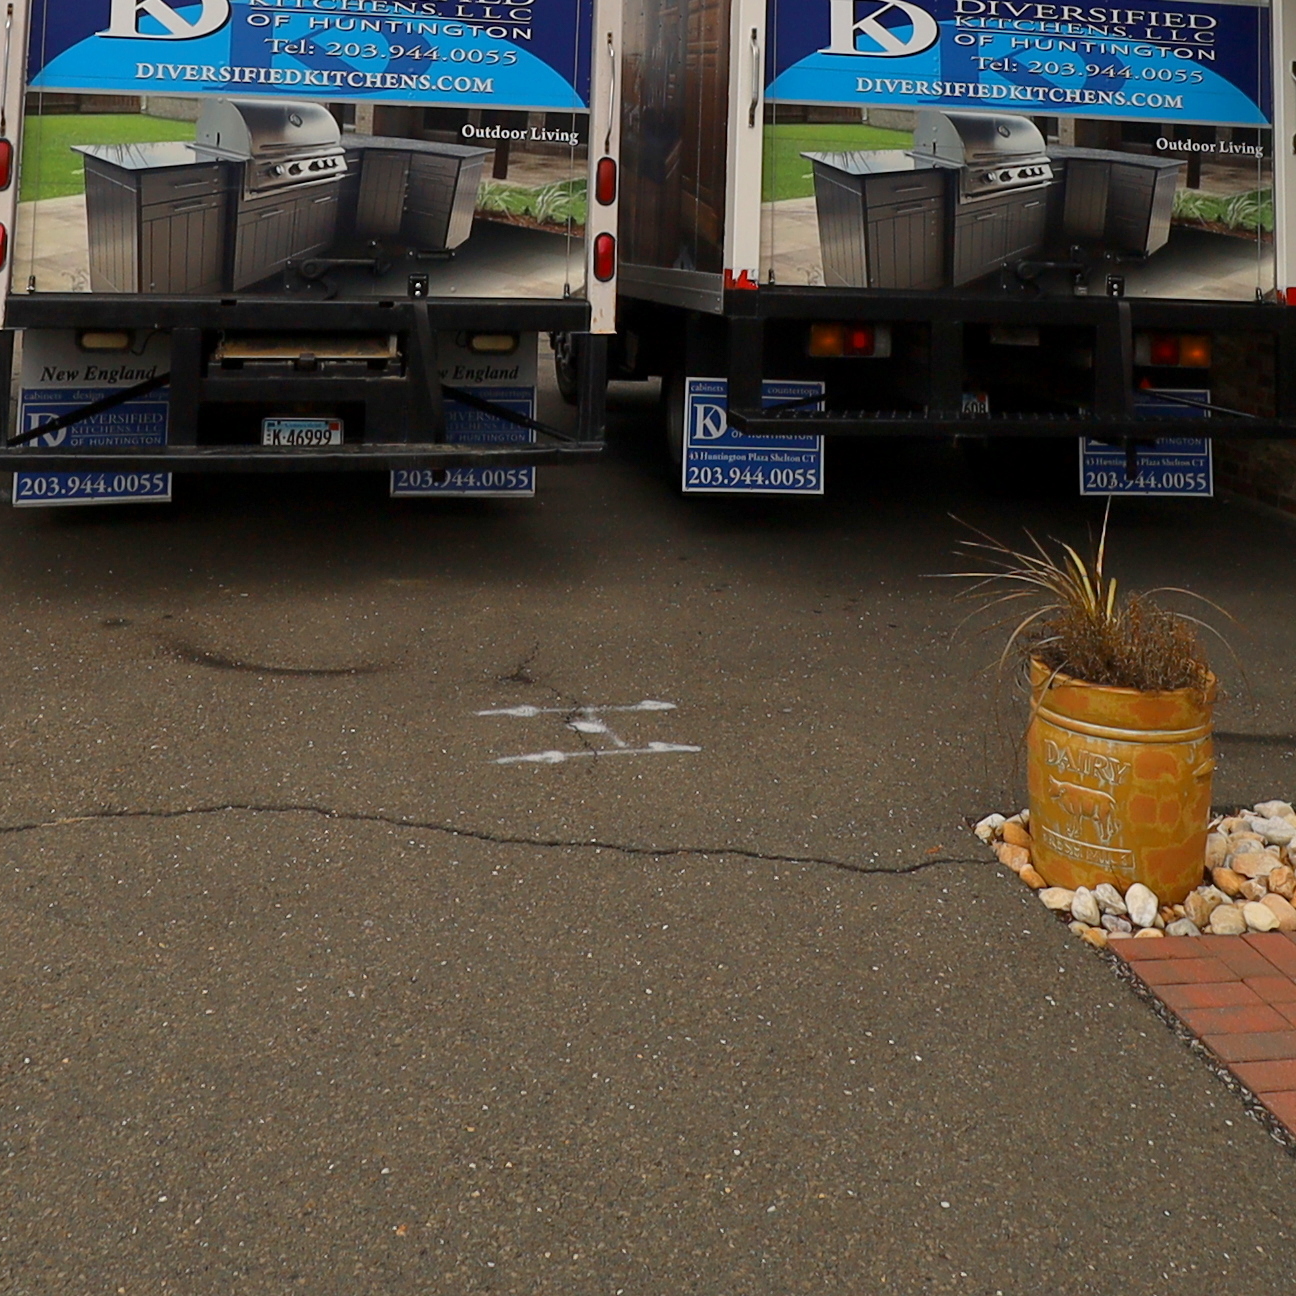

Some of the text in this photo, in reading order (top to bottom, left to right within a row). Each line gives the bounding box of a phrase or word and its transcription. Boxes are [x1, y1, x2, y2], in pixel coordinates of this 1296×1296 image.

[246, 13, 532, 41] OF HUNTINGTON
[263, 37, 519, 66] Tel: 203.944.0055
[953, 32, 1217, 61] OF HUNTINGTON
[134, 61, 495, 95] DIVERSIFIEDKITCHENS.COM
[970, 55, 1206, 84] Tel: 203.944.0055
[855, 76, 1184, 110] DIVERSIFIEDKITCHENS.COM
[461, 124, 579, 145] Outdoor Living
[1155, 136, 1265, 158] Outdoor Living
[40, 365, 157, 384] New England
[453, 365, 520, 383] England
[690, 382, 725, 393] cabinets
[70, 436, 162, 447] OF HUNTINGTON
[700, 452, 746, 463] Huntington
[801, 454, 817, 463] CT
[19, 473, 165, 497] 203.944.0055
[688, 465, 817, 488] 203.944.0055
[1044, 738, 1132, 786] DAIRY
